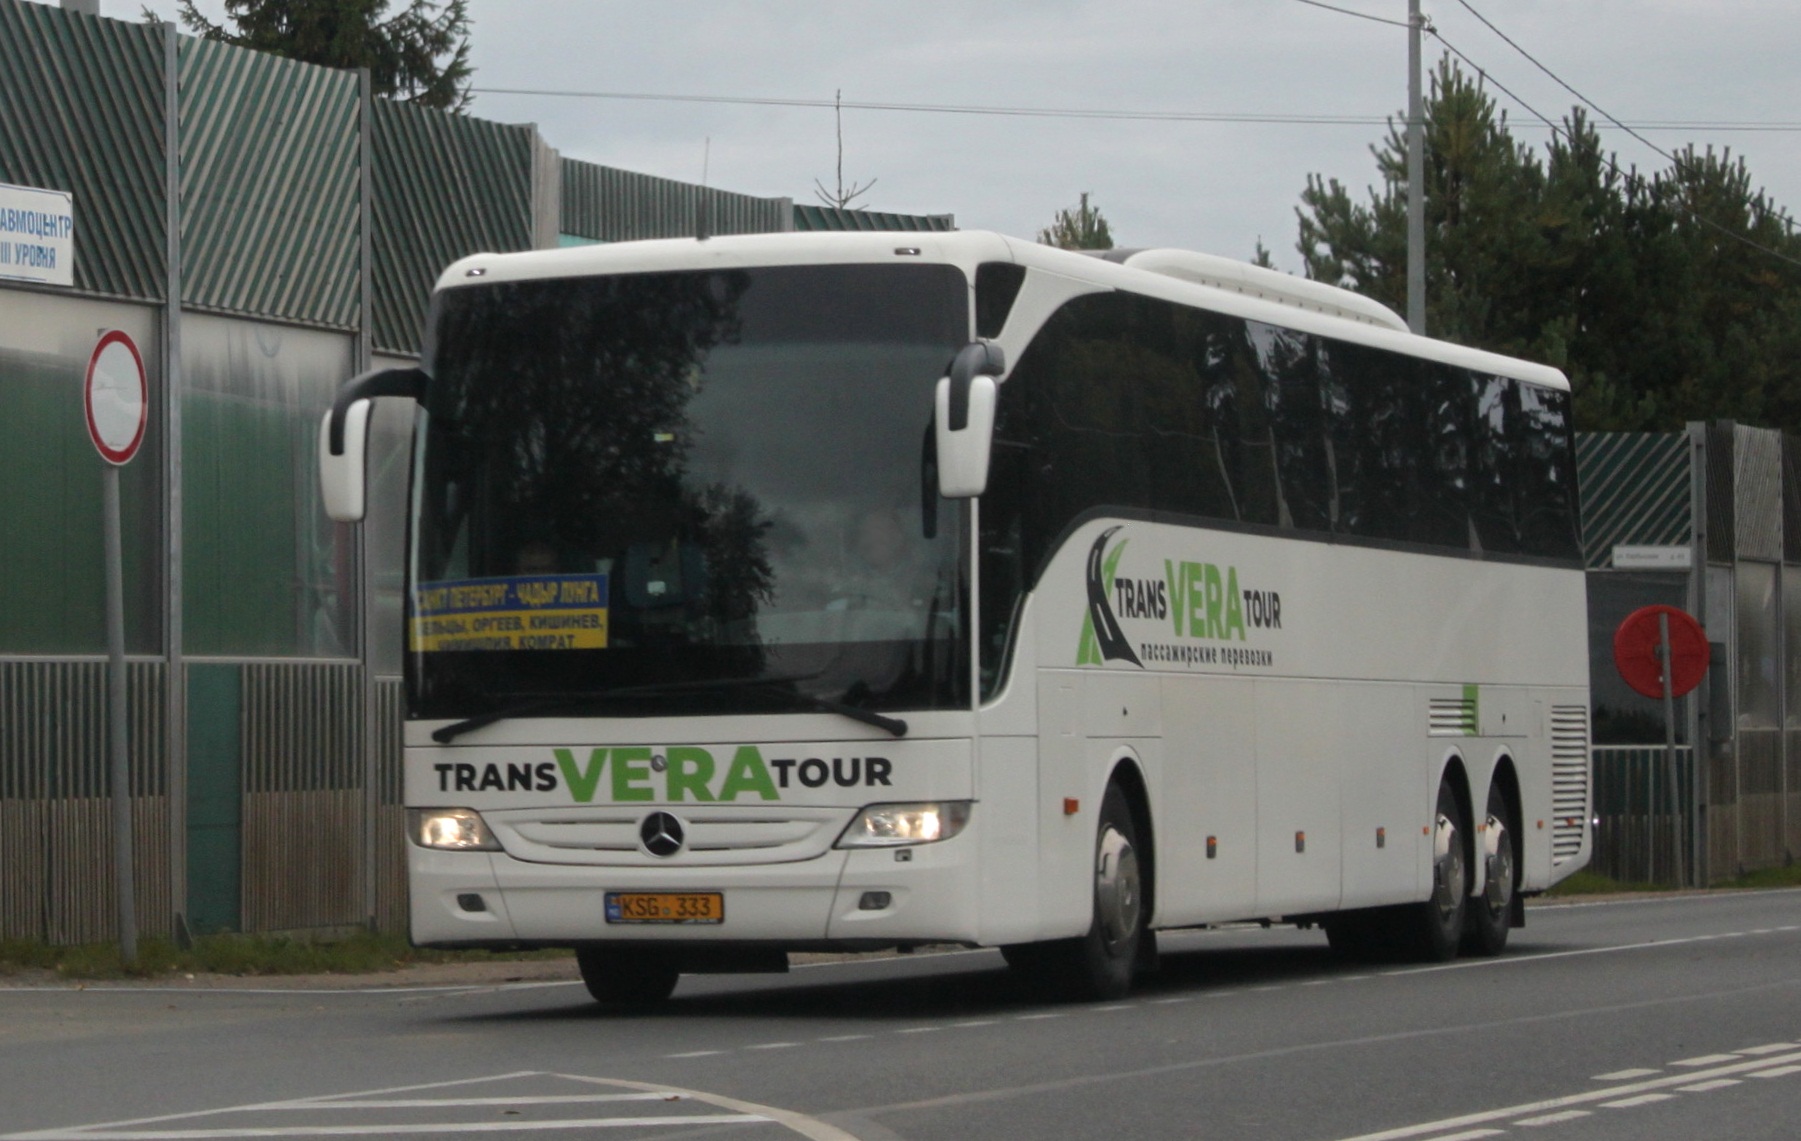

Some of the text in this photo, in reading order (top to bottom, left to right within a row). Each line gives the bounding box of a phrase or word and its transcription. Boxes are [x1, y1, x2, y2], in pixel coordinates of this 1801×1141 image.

[15, 243, 56, 269] УРОВНЯ
[450, 584, 508, 609] ПЕТЕРБУРГ
[560, 580, 600, 604] ЛУНГА
[1115, 558, 1282, 641] TRANS VERA TOUR
[1141, 642, 1274, 670] пассажирские перевозки
[434, 746, 892, 803] TRANS VERA TOUR
[623, 897, 660, 917] KSG
[676, 897, 711, 917] 333
